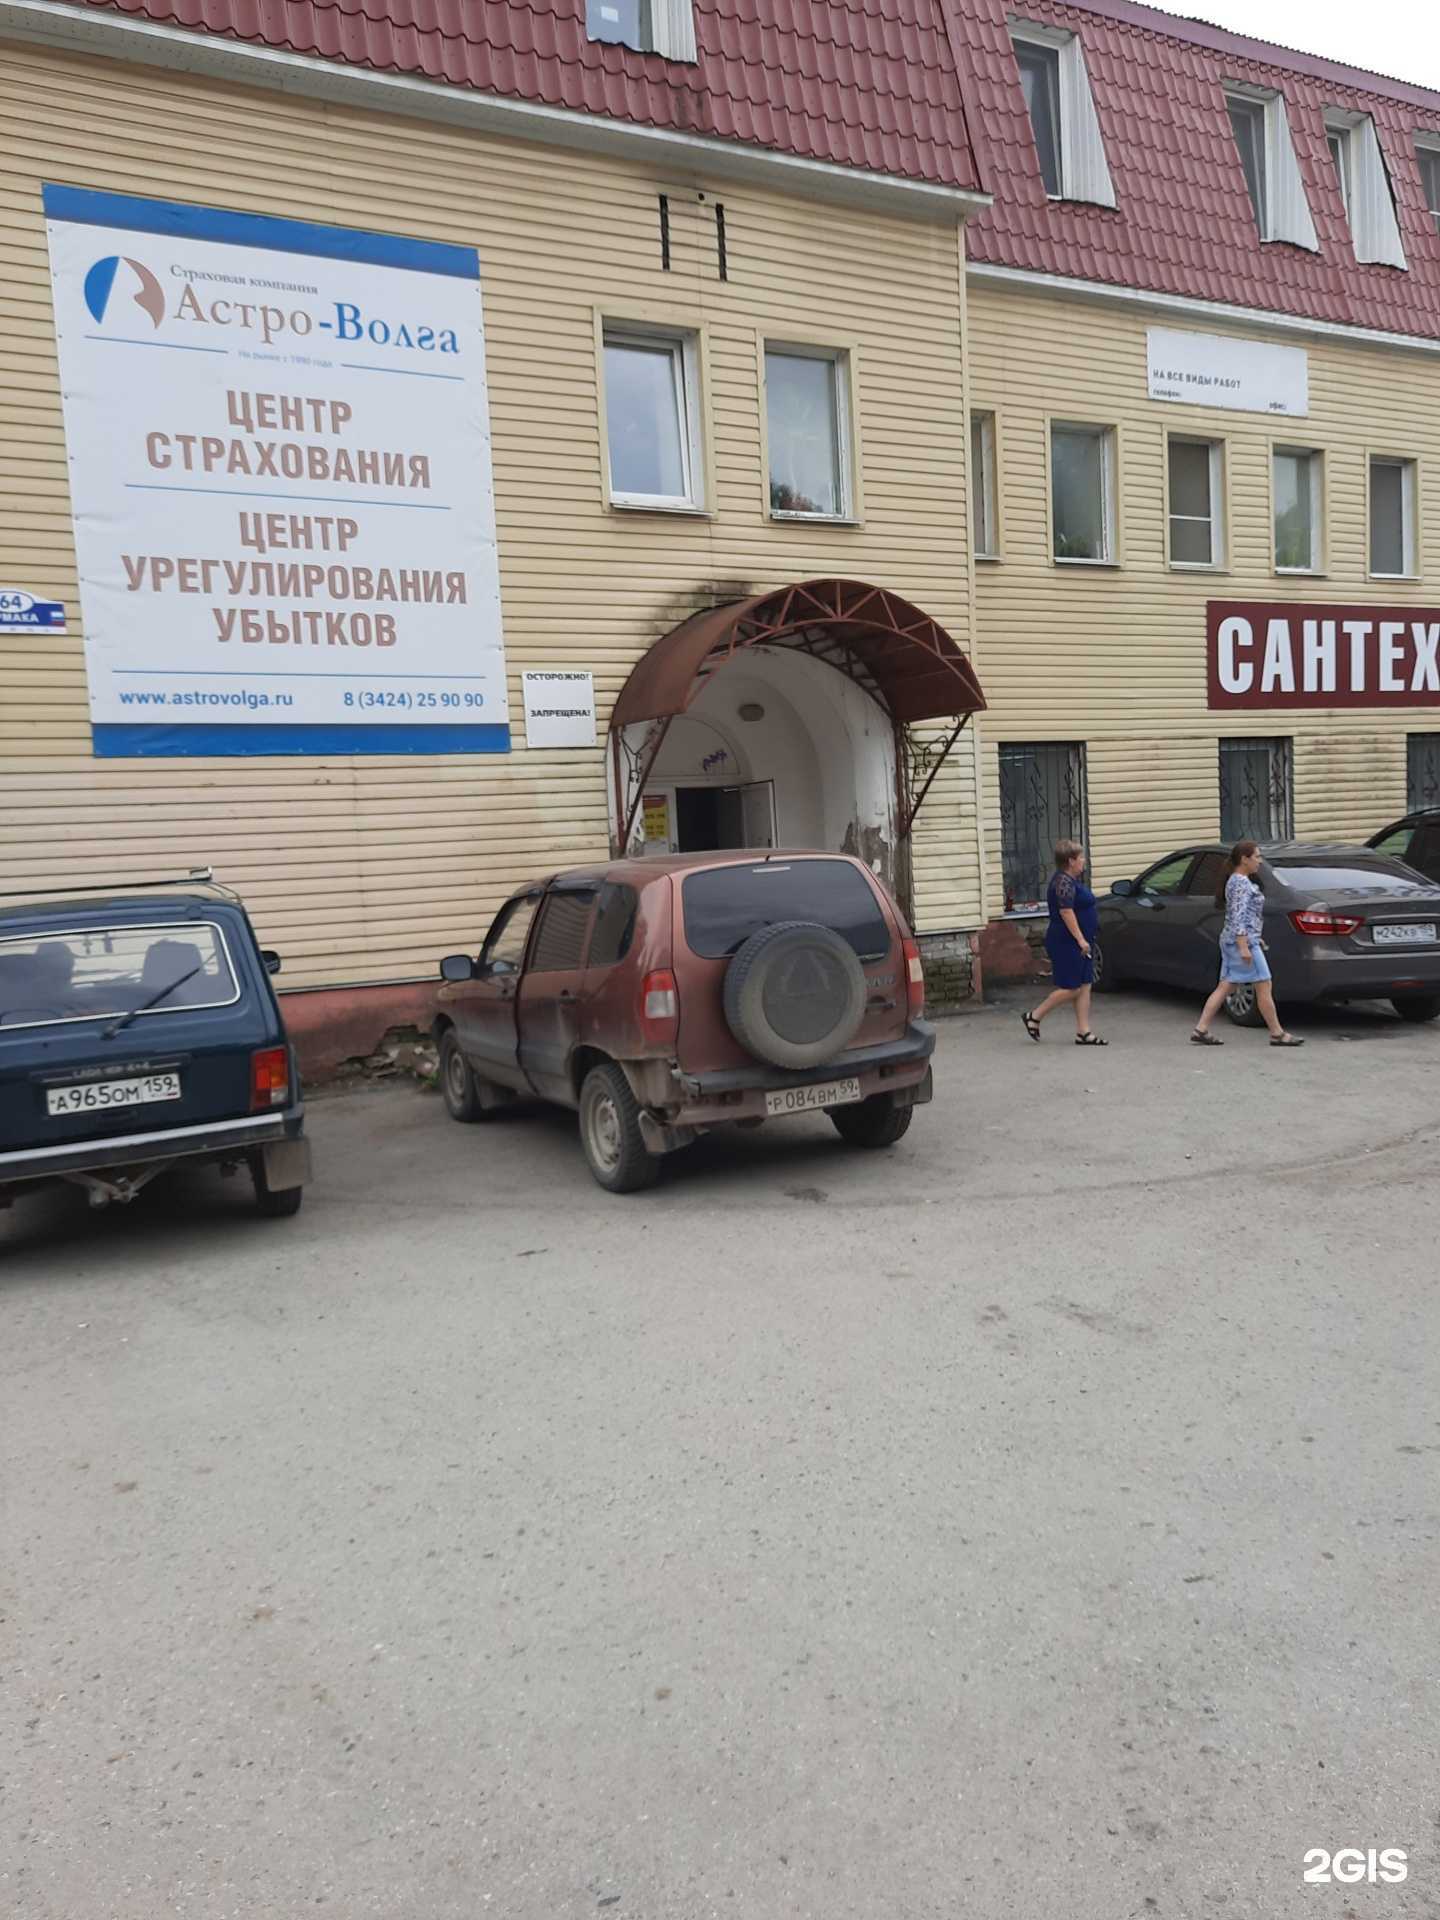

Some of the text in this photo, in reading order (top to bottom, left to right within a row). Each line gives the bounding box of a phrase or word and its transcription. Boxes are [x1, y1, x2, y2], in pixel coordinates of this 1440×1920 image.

[170, 264, 319, 295] Страховая компания
[173, 283, 461, 354] Астро-Волга
[1153, 369, 1241, 389] НА ВСЕ ВИДЫ РАБОТ
[226, 390, 352, 434] ЦЕНТР
[146, 431, 430, 488] СТРАХОВАНИЯ
[239, 511, 358, 553] ЦЕНТР
[121, 555, 467, 604] УРЕГУЛИРОВАНИЯ
[212, 608, 397, 647] УБЫТКОВ
[1218, 617, 1440, 694] САНТЕХ
[526, 673, 590, 681] ОСТОРОЖНО!
[119, 690, 293, 709] www.astrovolga.ru
[343, 692, 484, 709] 8 (3424) 25 90 90
[530, 709, 592, 718] ЗАПРЕЩЕНА!
[143, 1076, 173, 1093] 159
